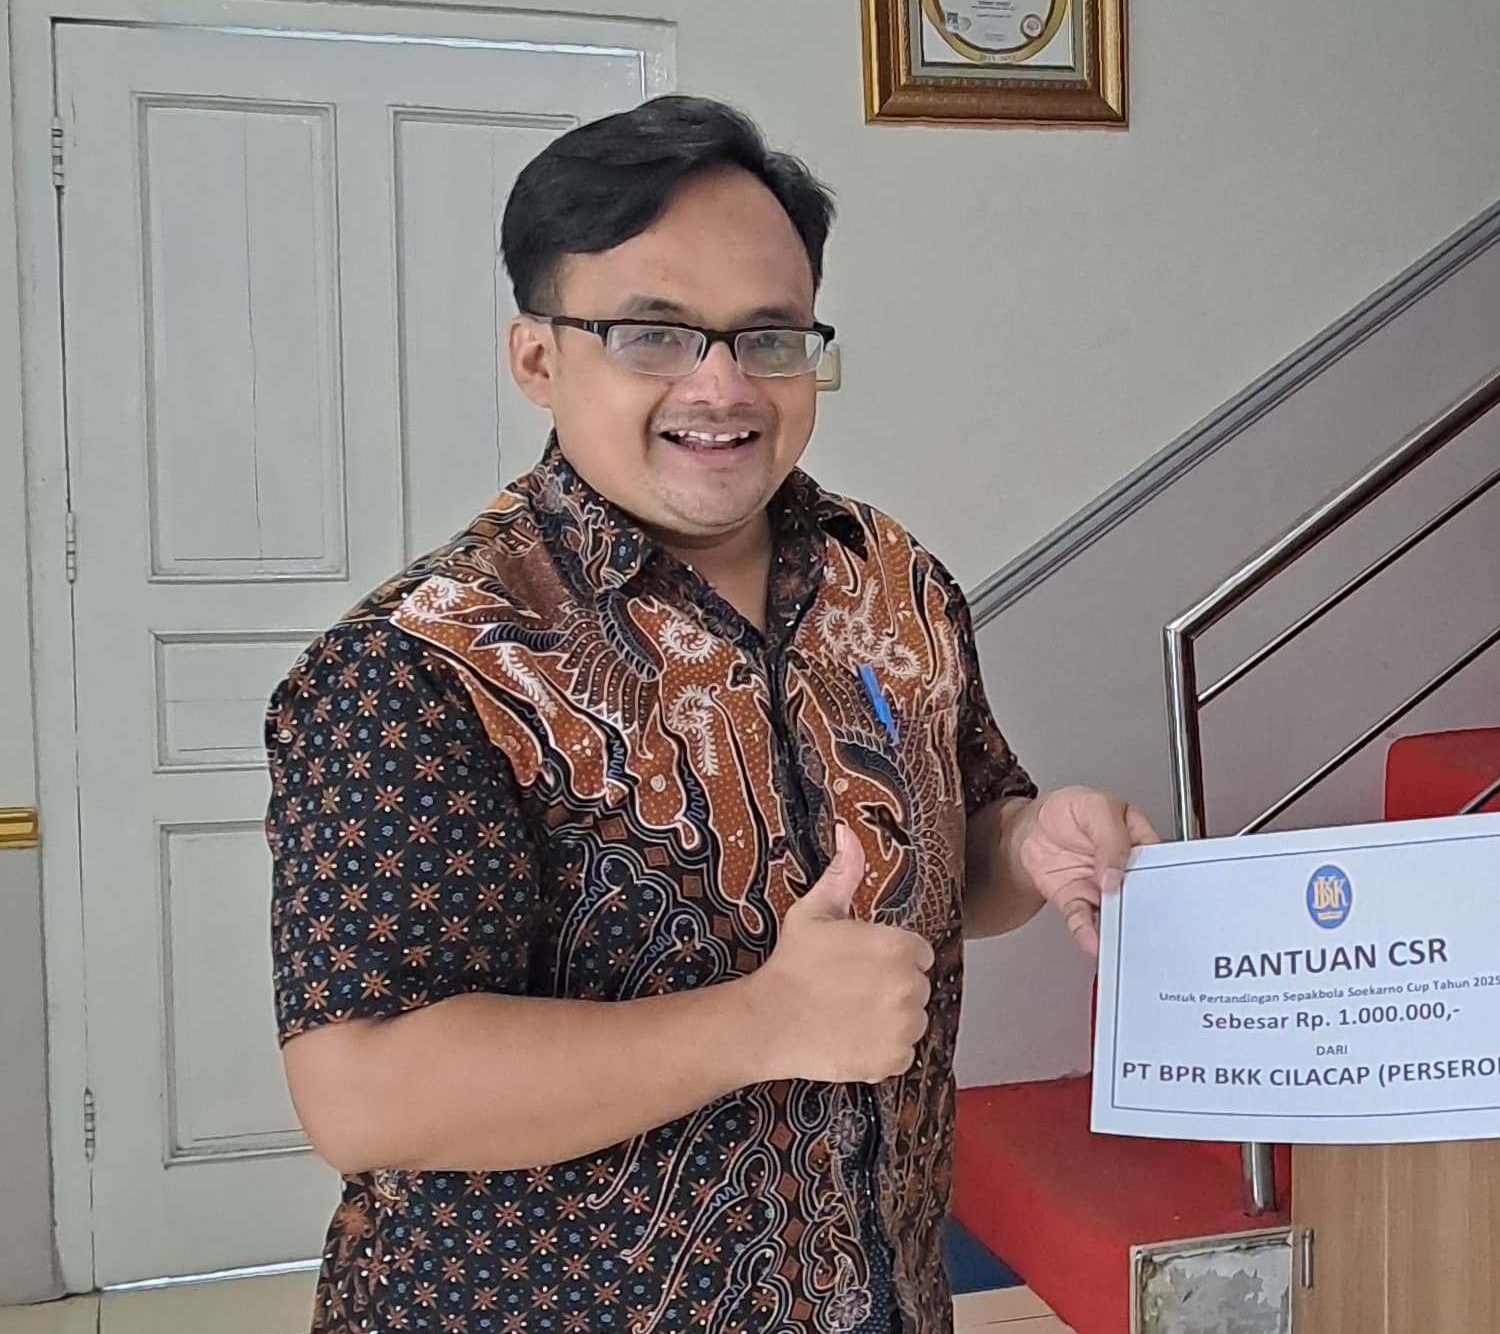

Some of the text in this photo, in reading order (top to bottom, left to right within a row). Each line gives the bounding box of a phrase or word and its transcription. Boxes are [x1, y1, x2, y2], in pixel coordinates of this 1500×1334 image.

[1213, 937, 1449, 980] BANTUAN CSR
[1159, 991, 1196, 1003] Untuk
[1199, 990, 1280, 1005] Pertandingan
[1282, 987, 1344, 1002] Sepakbola
[1347, 982, 1404, 997] Soekarno
[1406, 981, 1430, 996] Cup
[1433, 977, 1470, 992] Tahun
[1201, 1001, 1462, 1032] Sebesar Rp. 1.000.000,-
[1316, 1044, 1348, 1057] DARI
[1121, 1061, 1152, 1081] PT
[1159, 1063, 1206, 1084] BPR
[1214, 1066, 1262, 1086] BKK
[1269, 1065, 1371, 1087] CILACAP
